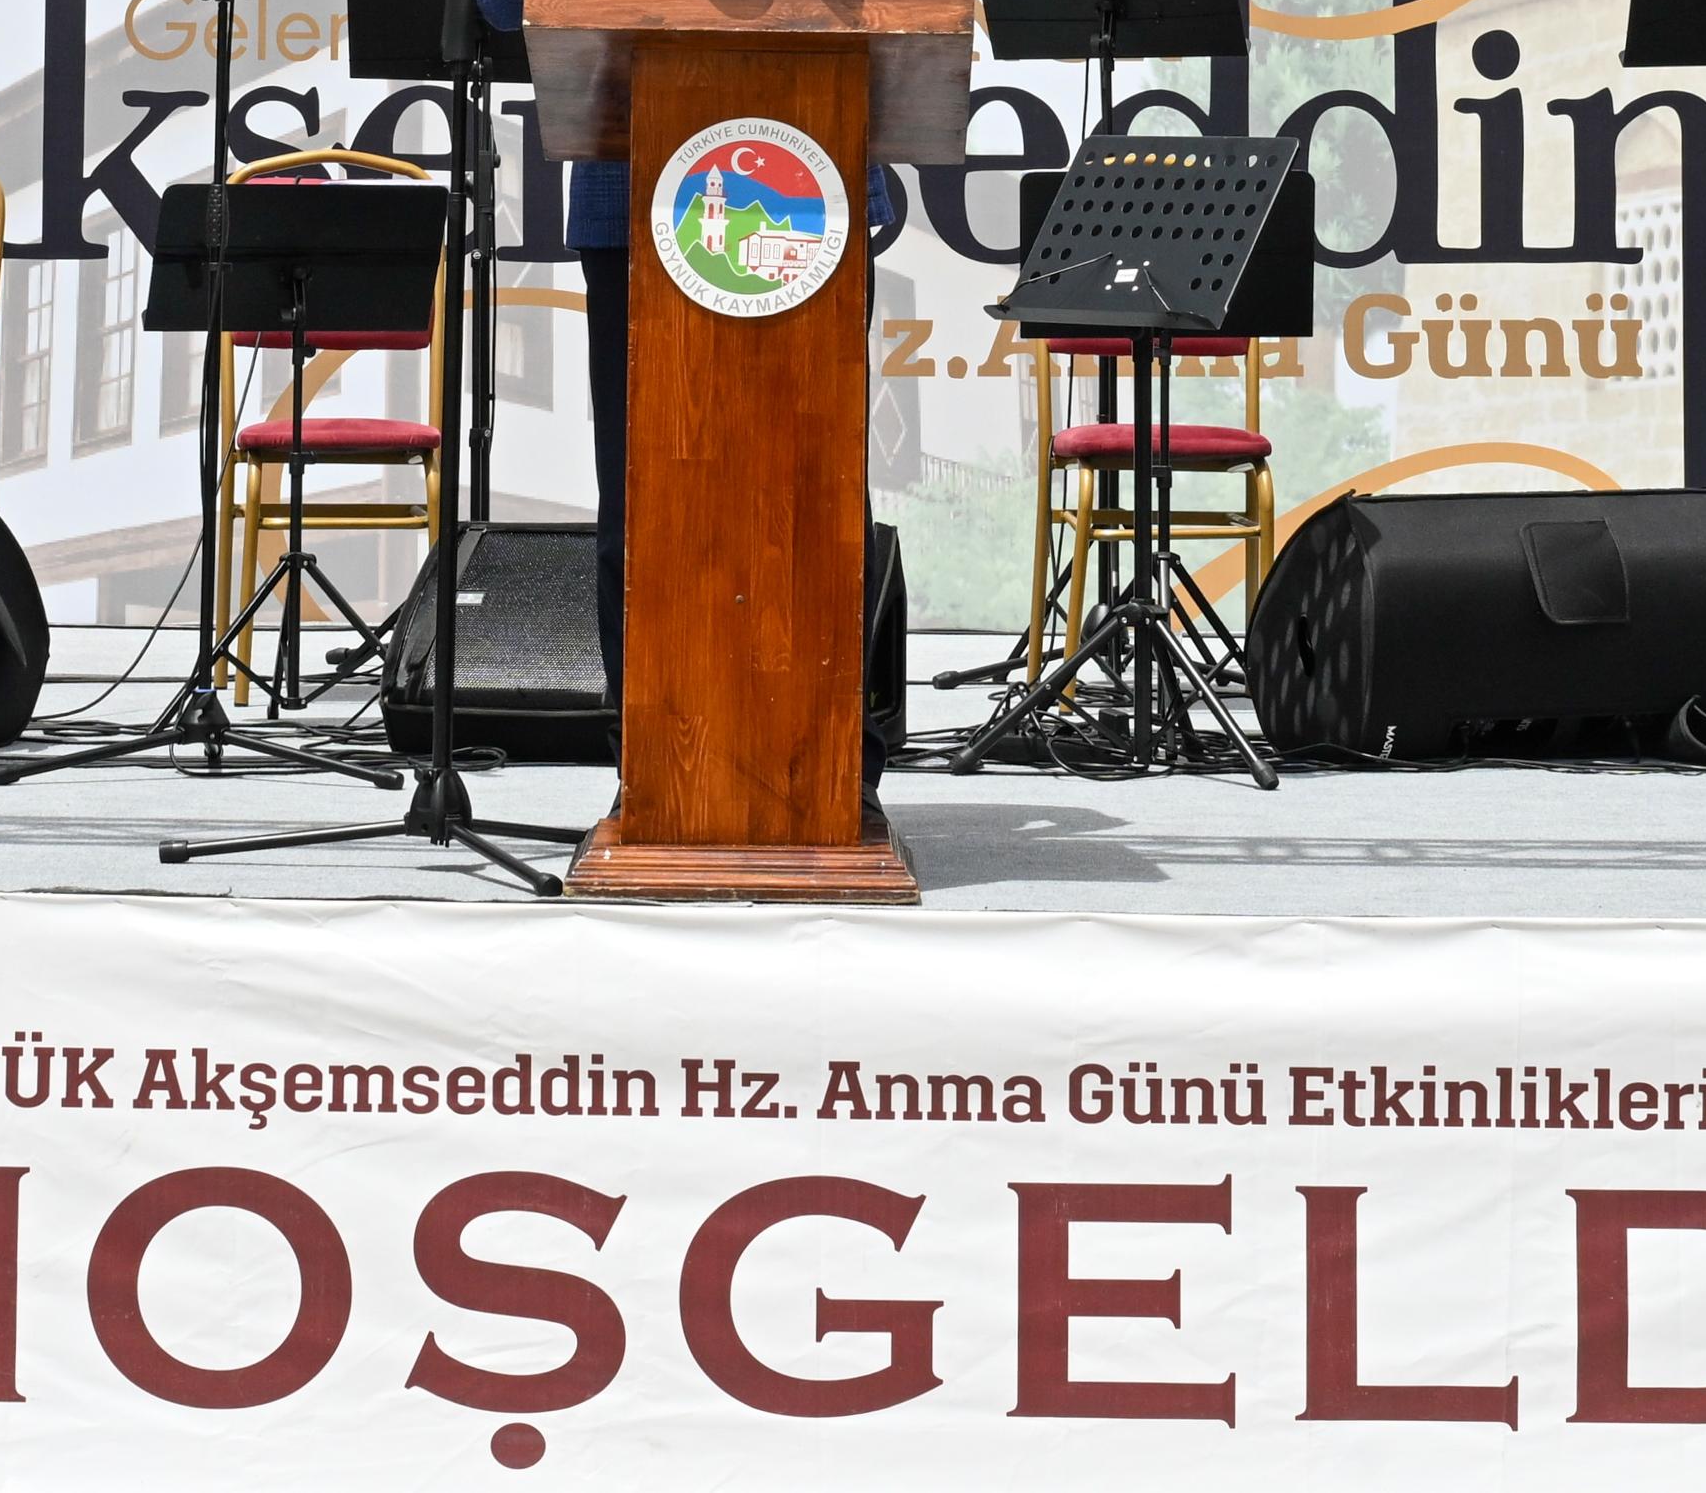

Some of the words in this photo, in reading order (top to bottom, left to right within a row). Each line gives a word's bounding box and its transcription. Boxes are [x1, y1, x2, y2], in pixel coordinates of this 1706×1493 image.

[676, 125, 733, 165] TÜRKİYE
[737, 123, 829, 173] CUMHURİYETİ
[654, 221, 710, 301] GÖYNÜK
[712, 228, 843, 314] KAYMAKAMLIĞI
[1343, 292, 1643, 380] Günü
[133, 1047, 659, 1130] Akşemseddin
[680, 1058, 797, 1120] Hz.
[822, 1060, 1046, 1124] Anma
[1068, 1062, 1267, 1126] Günü
